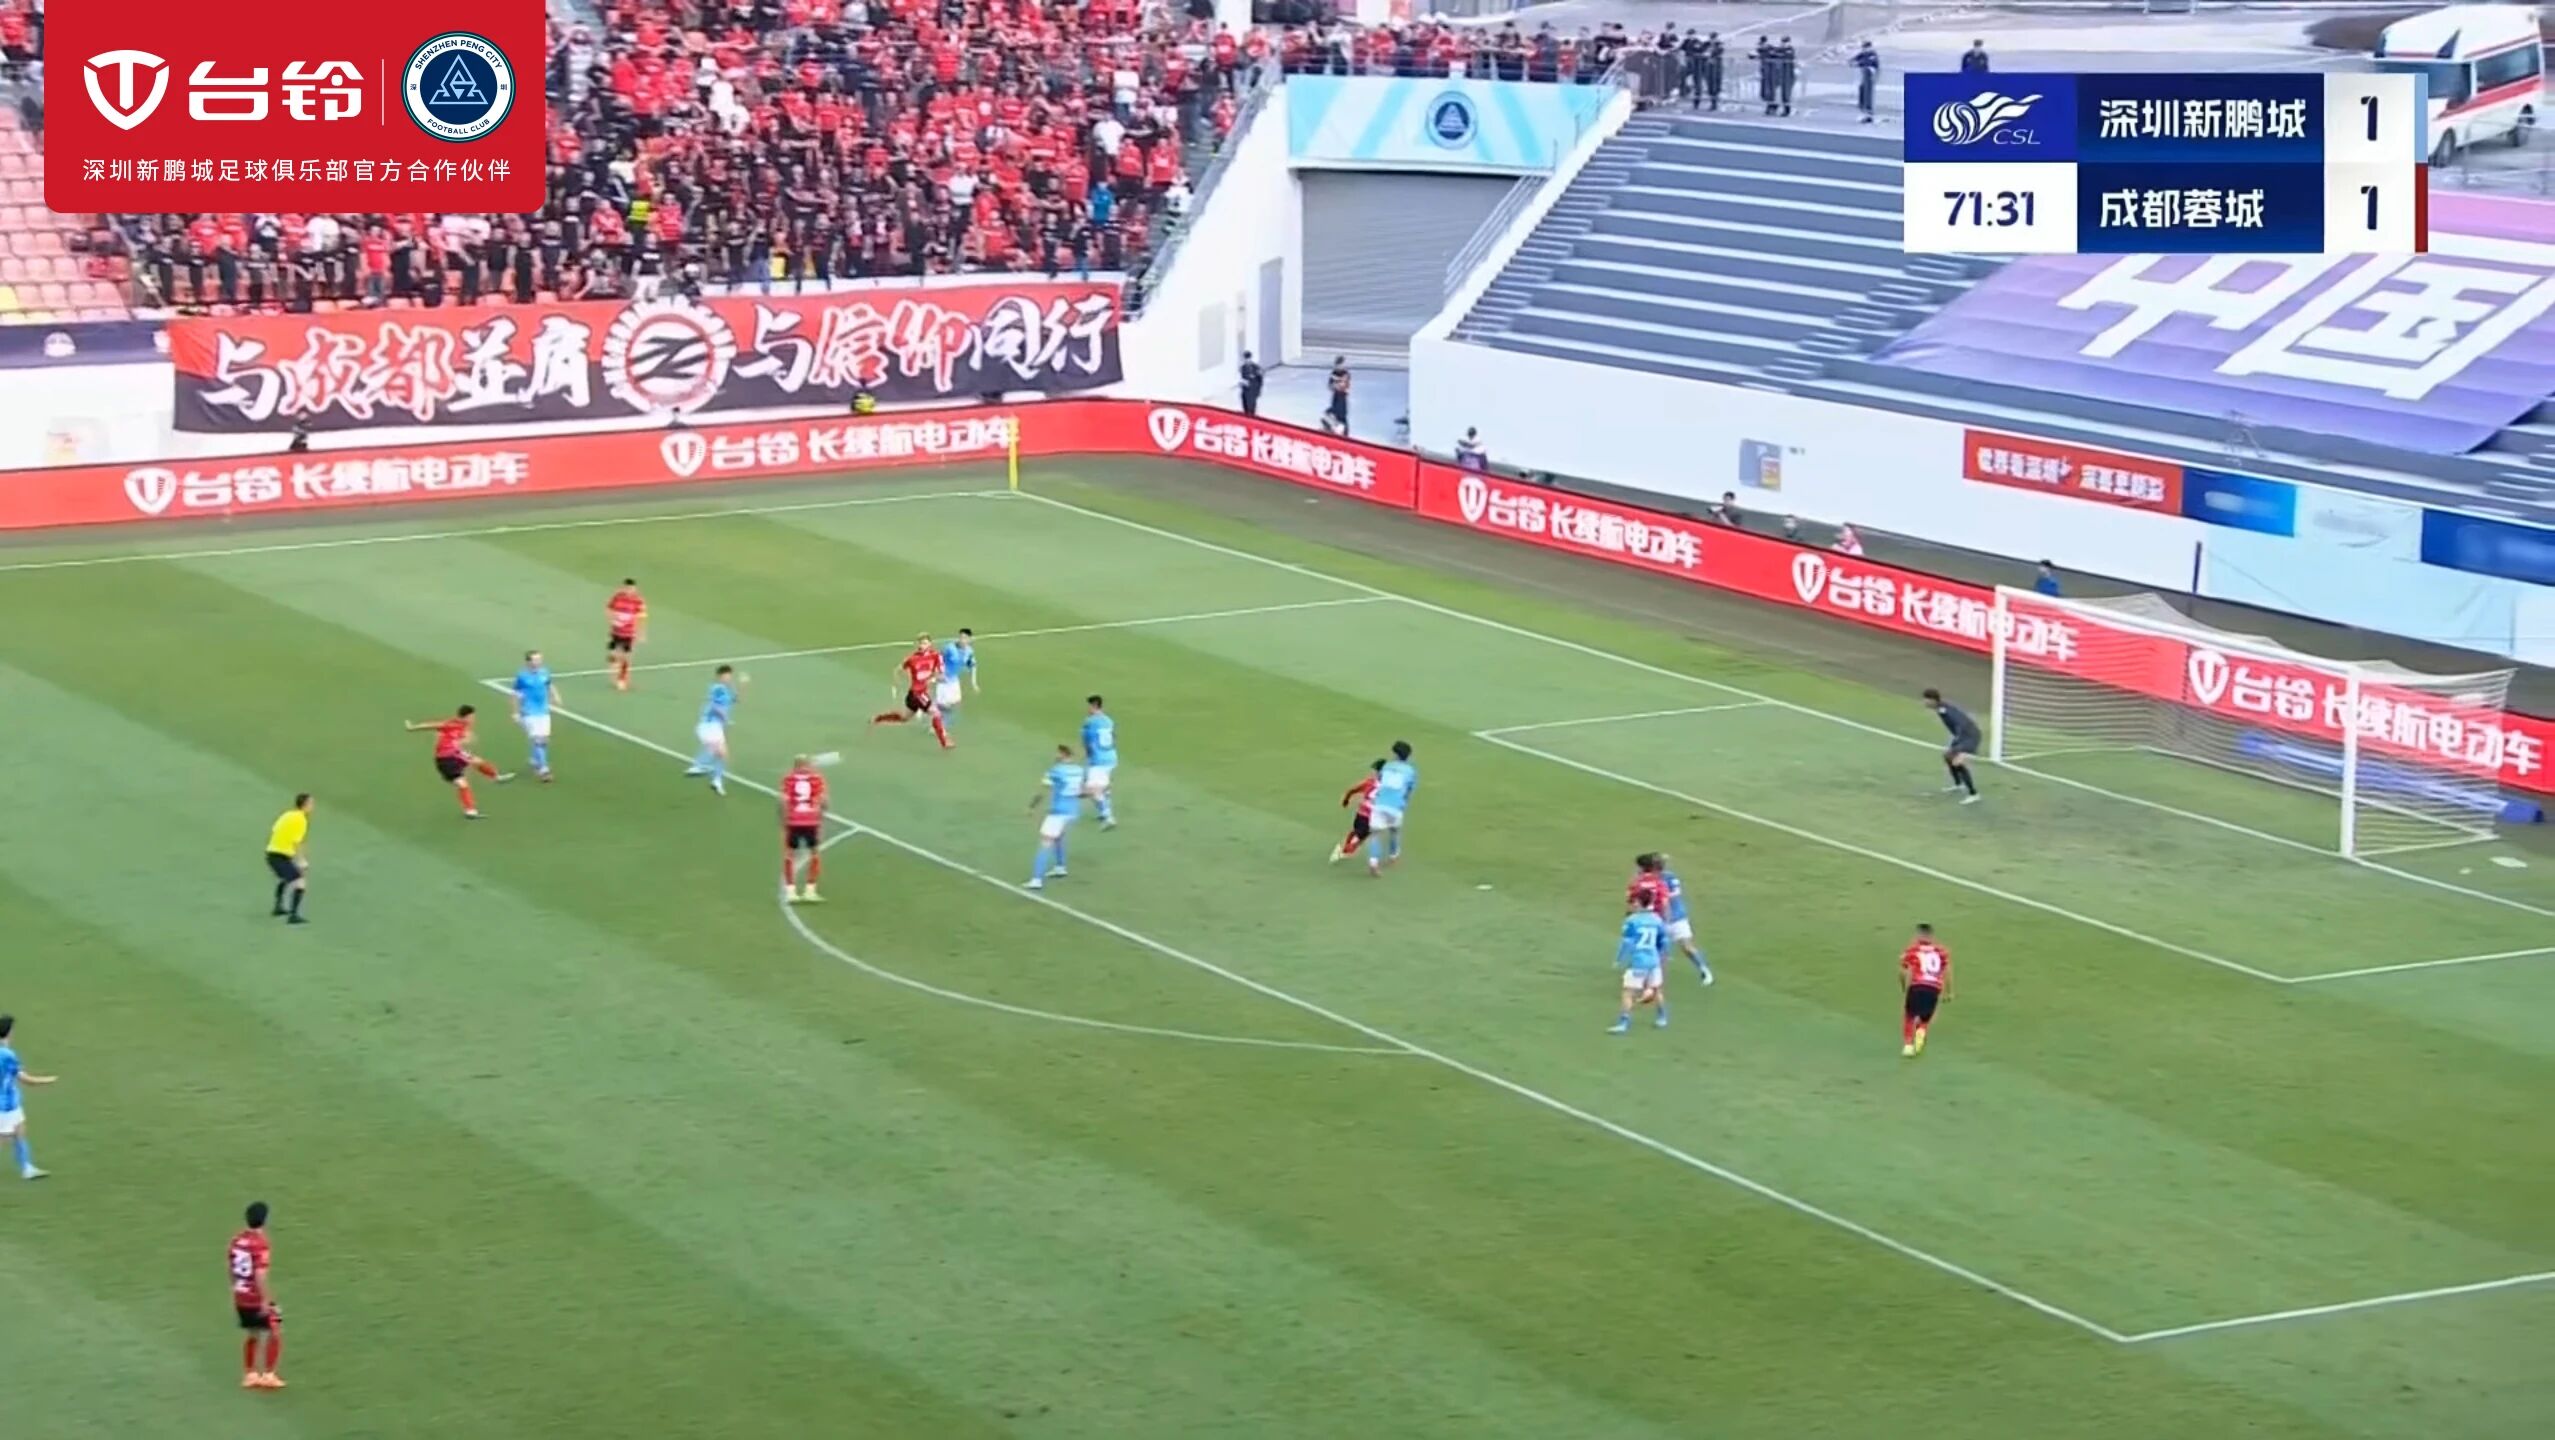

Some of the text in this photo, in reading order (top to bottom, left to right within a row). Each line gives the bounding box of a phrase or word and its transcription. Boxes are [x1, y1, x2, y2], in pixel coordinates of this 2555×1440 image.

[734, 294, 1113, 393] 与信仰同行
[2056, 232, 2555, 400] 中国
[183, 450, 530, 507] 台铃 长续航电动车
[712, 415, 1020, 470] 台铃 长续航电动车
[1193, 418, 1377, 490] 台铃 长续航电动车
[1488, 489, 1703, 568] 台铃 长续航电动车
[1828, 566, 2080, 662] 台铃 长续航电动车
[2232, 665, 2544, 775] 台铃 长续航电动车
[1635, 926, 1658, 950] 21
[1917, 950, 1942, 976] 10
